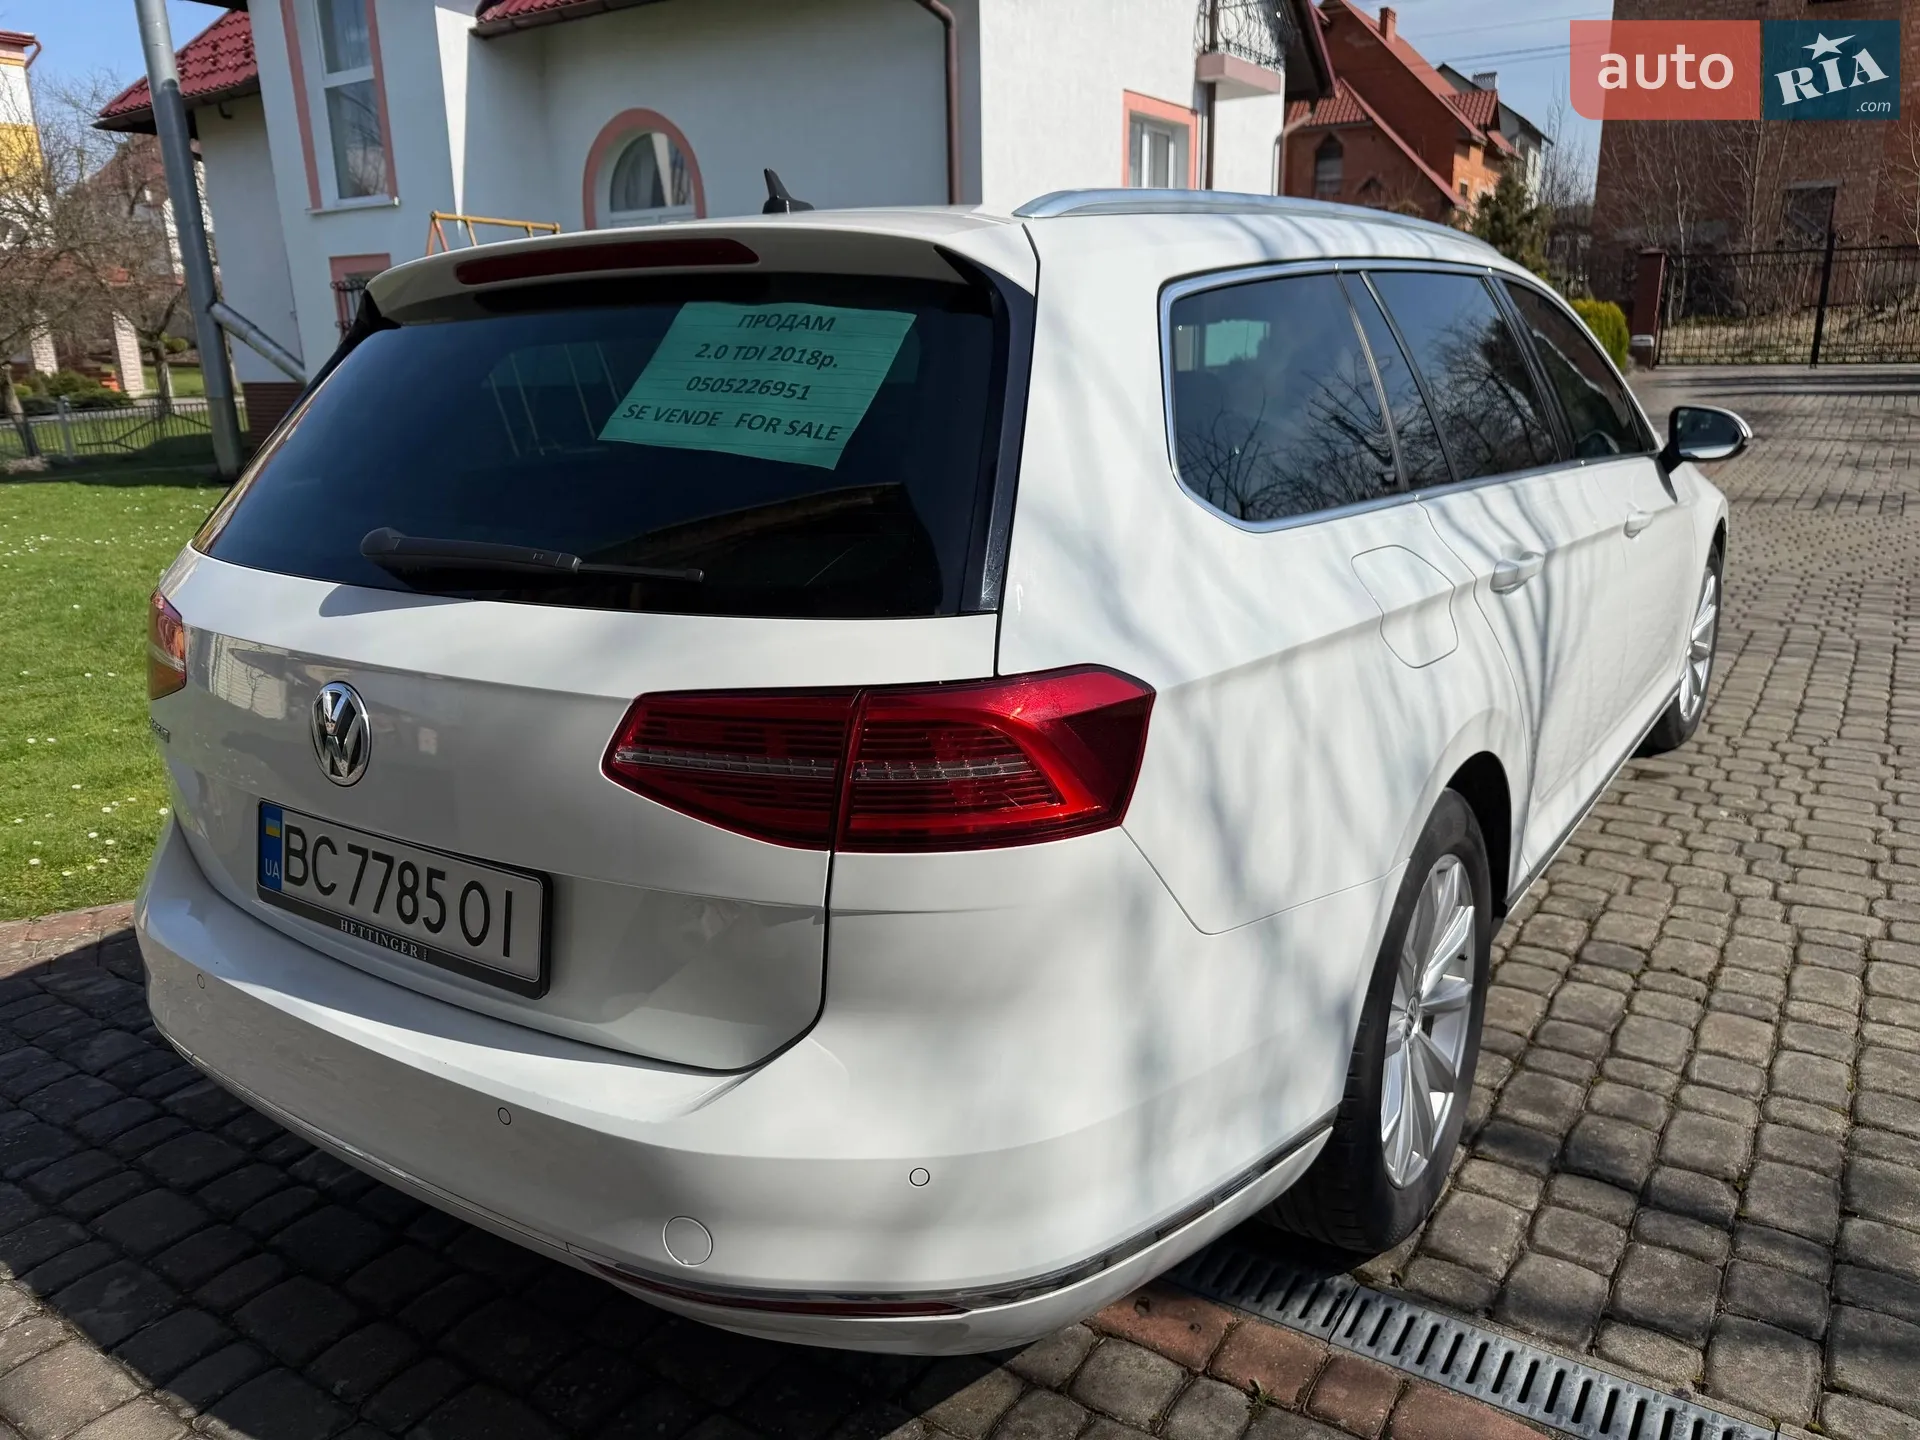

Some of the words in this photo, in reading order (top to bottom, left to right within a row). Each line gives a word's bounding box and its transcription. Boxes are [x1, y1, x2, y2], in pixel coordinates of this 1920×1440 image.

[737, 313, 836, 332] ПРОДАМ
[695, 343, 729, 360] 2.0
[733, 345, 767, 361] TDI
[686, 376, 811, 400] 0505226951
[622, 404, 649, 420] SE
[653, 407, 723, 426] VENDE
[734, 414, 781, 434] FOR
[783, 420, 842, 441] SALE
[265, 858, 280, 880] UA
[340, 919, 418, 958] HETTINGER
